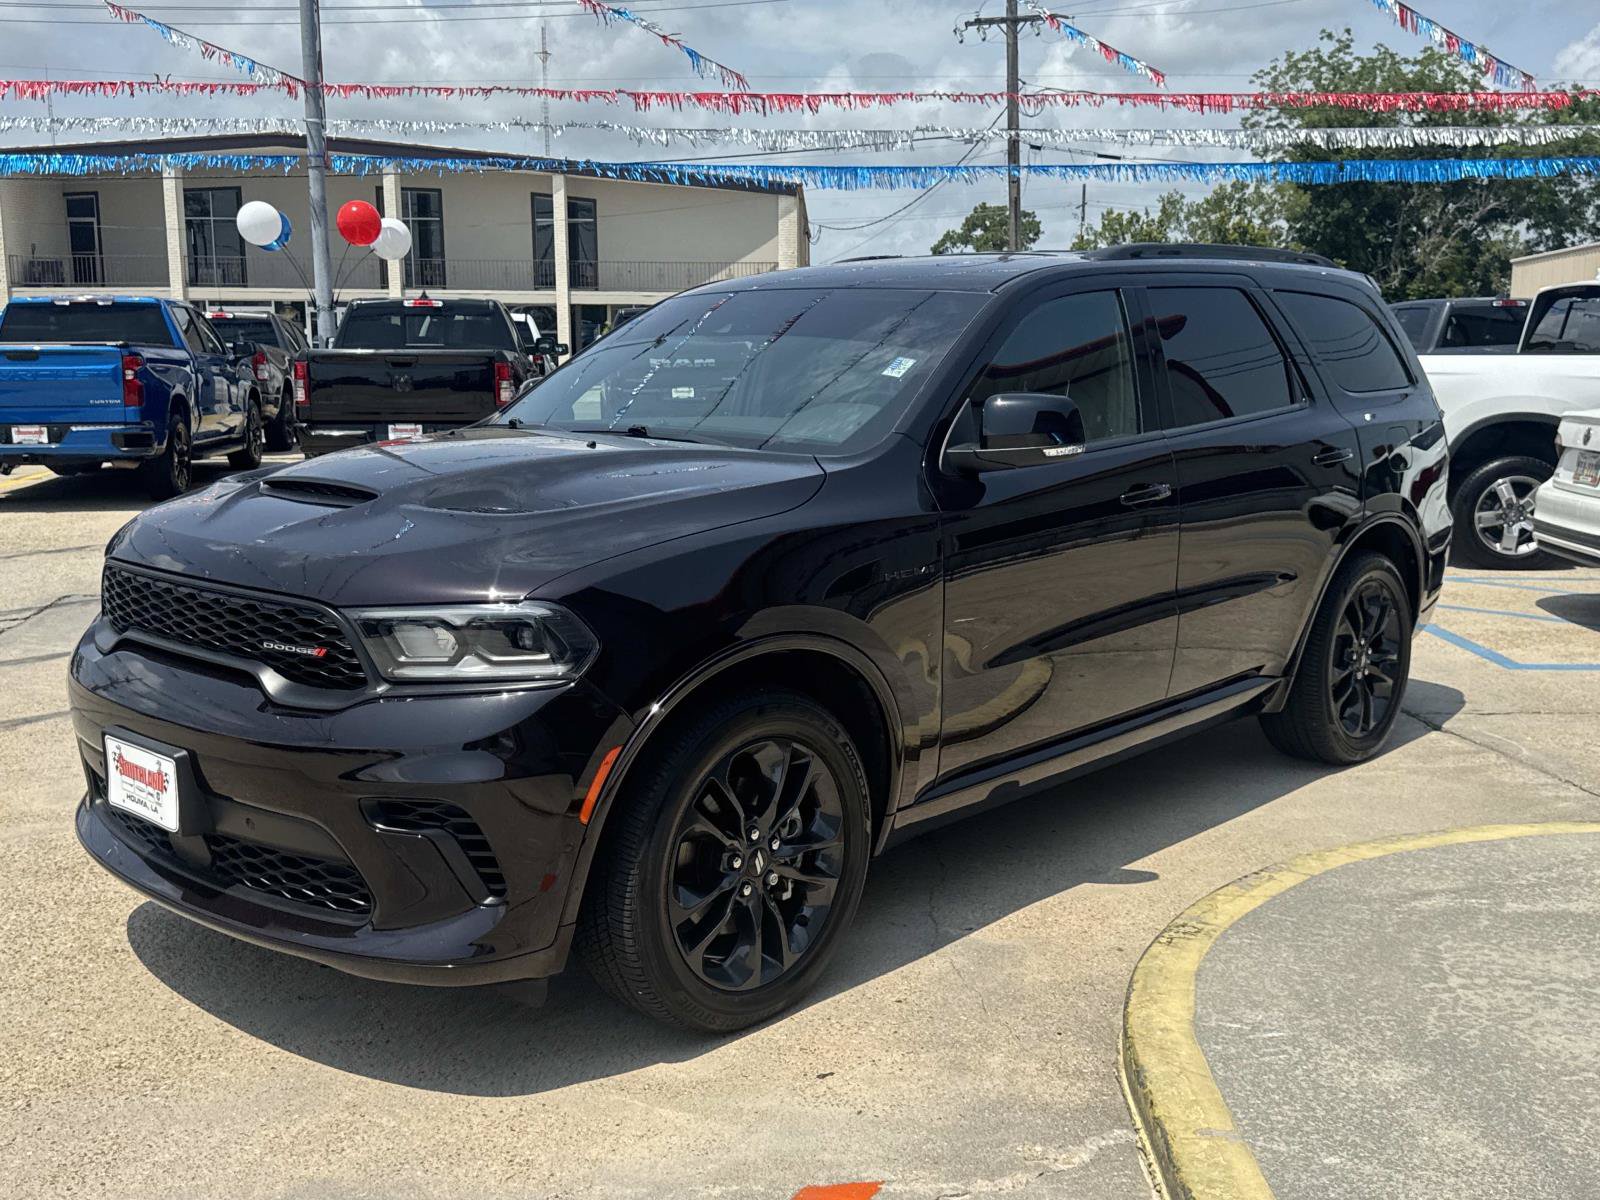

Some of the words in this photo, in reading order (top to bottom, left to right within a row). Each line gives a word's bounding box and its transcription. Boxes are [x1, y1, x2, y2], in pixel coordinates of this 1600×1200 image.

[649, 358, 716, 368] RAM
[263, 641, 316, 656] DODGE
[150, 805, 159, 814] LA
